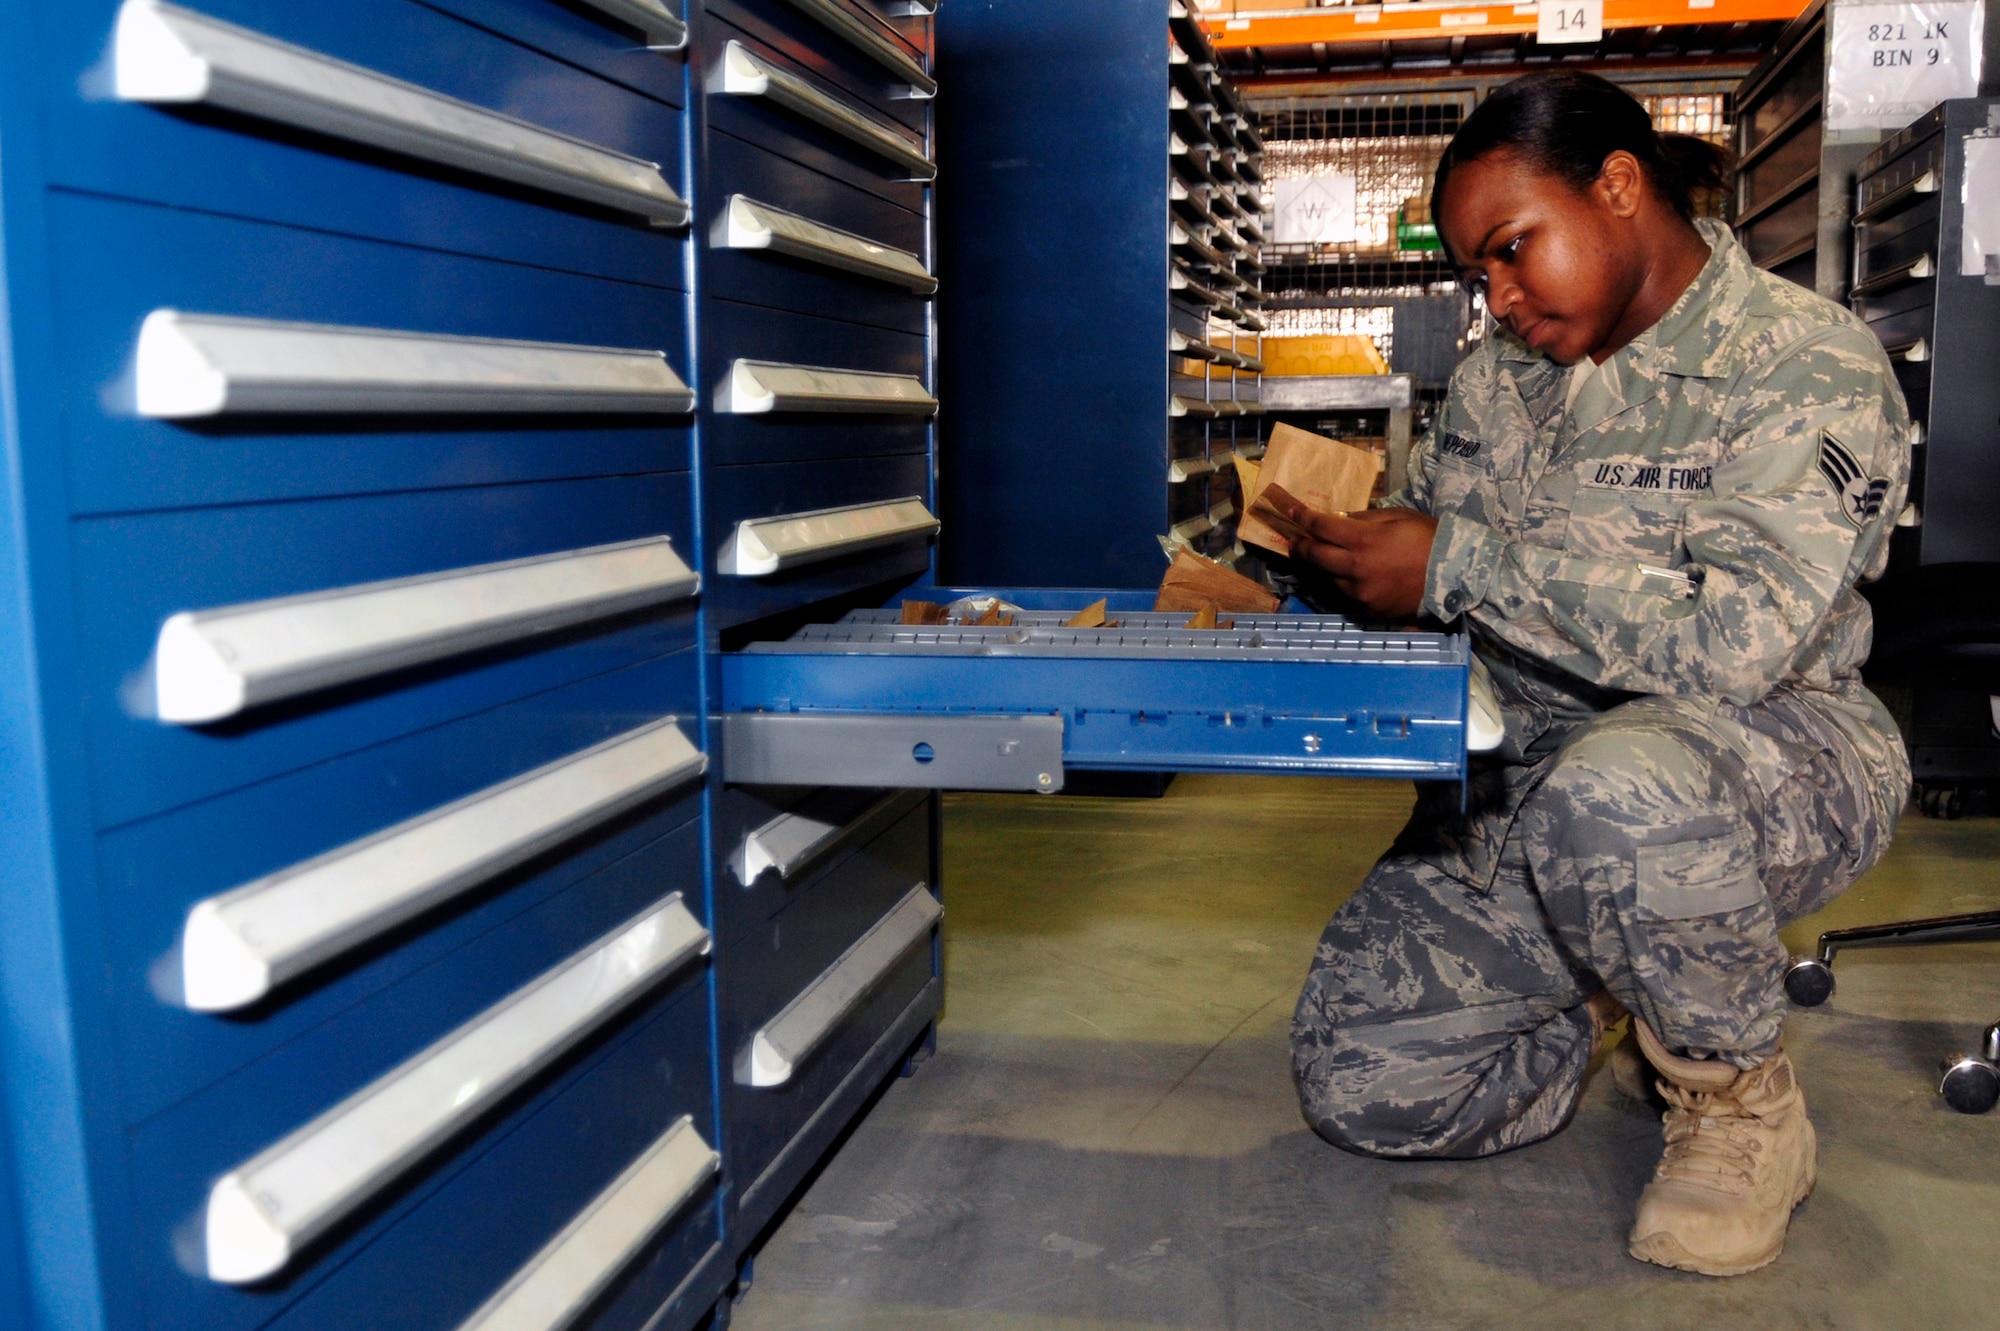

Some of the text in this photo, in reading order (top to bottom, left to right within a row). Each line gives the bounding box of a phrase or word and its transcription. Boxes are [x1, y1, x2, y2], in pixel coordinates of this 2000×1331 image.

[1556, 8, 1587, 30] 14
[1868, 23, 1907, 41] 821
[1873, 47, 1939, 67] BIN 9
[1594, 463, 1625, 486] U.S.
[1629, 466, 1662, 489] AIR
